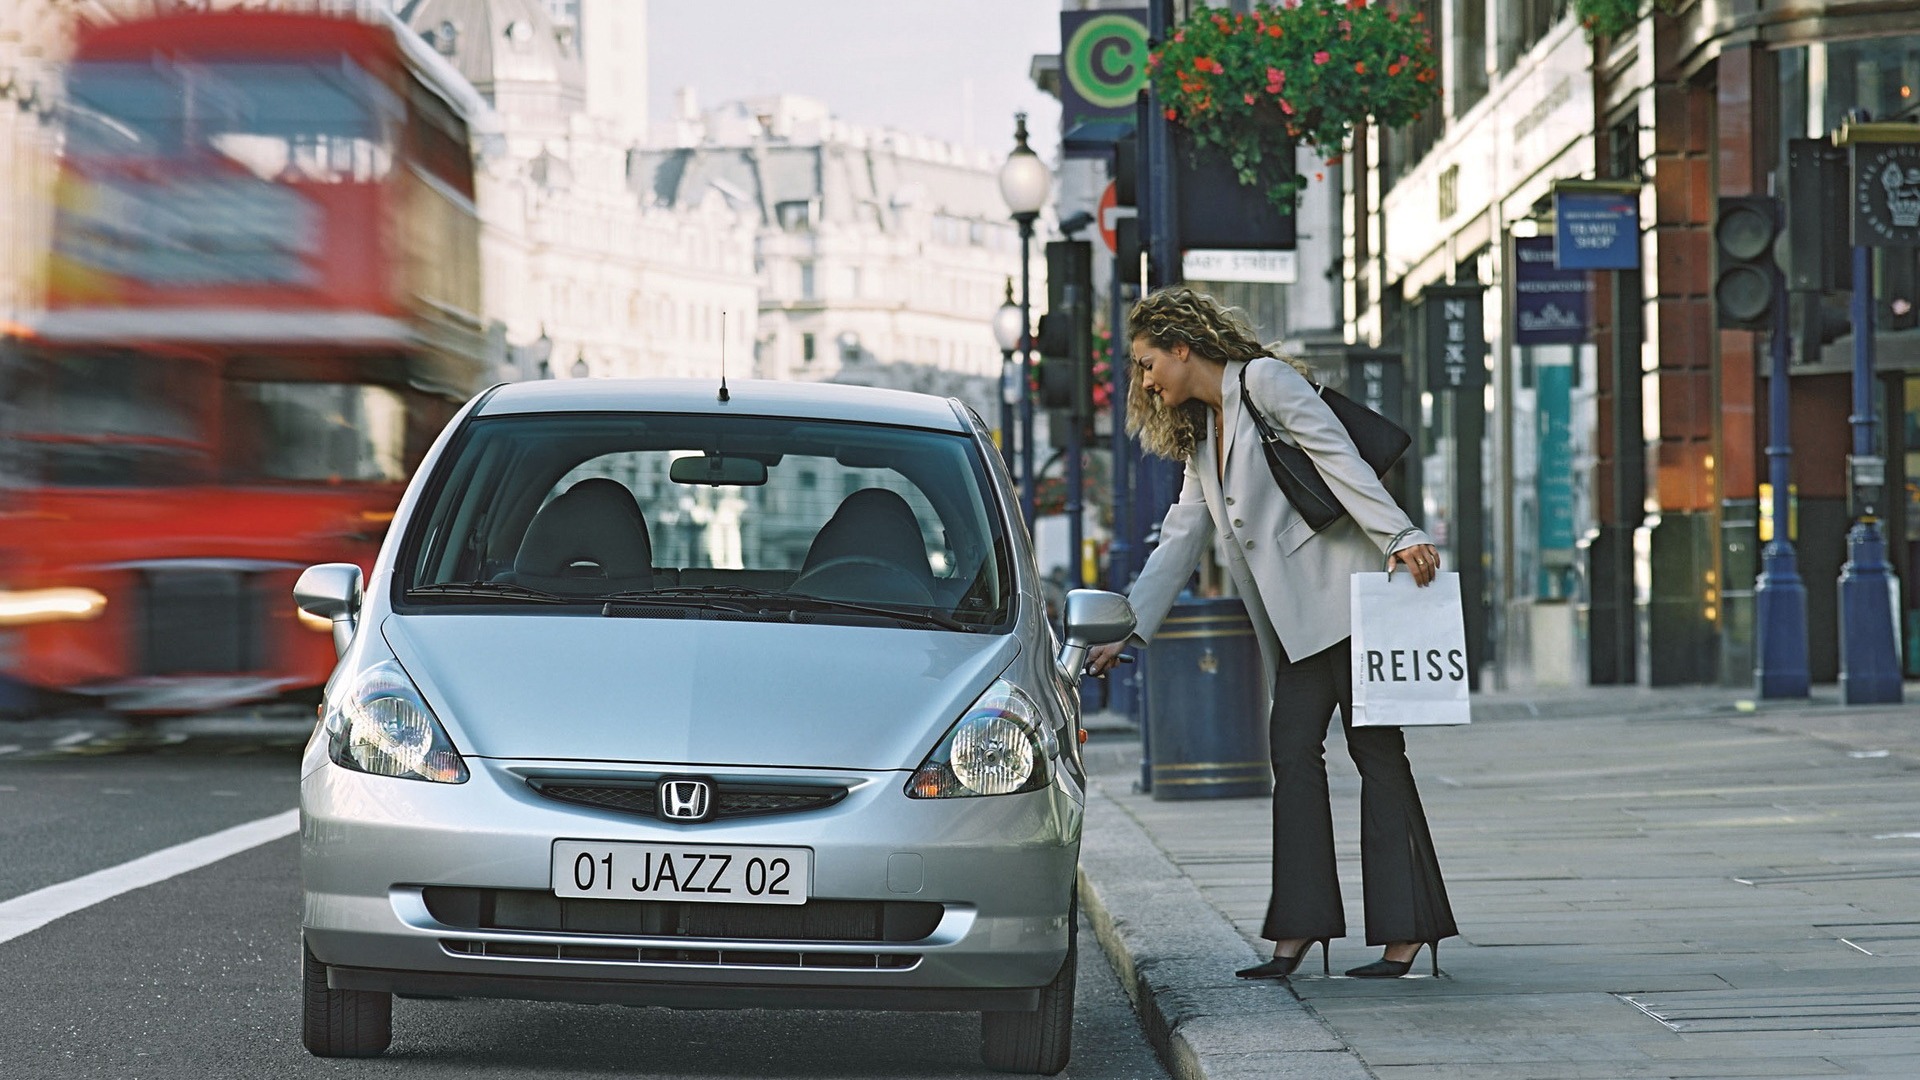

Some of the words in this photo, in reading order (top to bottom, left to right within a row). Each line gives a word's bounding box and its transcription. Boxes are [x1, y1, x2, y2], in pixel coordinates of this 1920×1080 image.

[1569, 222, 1620, 236] TRAVEL
[1574, 236, 1614, 249] SHOP
[1232, 254, 1290, 271] STREET
[1444, 300, 1466, 386] NEXT
[1363, 362, 1383, 415] NEX
[1366, 649, 1464, 682] REISS
[574, 852, 613, 891] 01
[631, 852, 732, 894] JAZZ
[745, 857, 790, 896] 02
